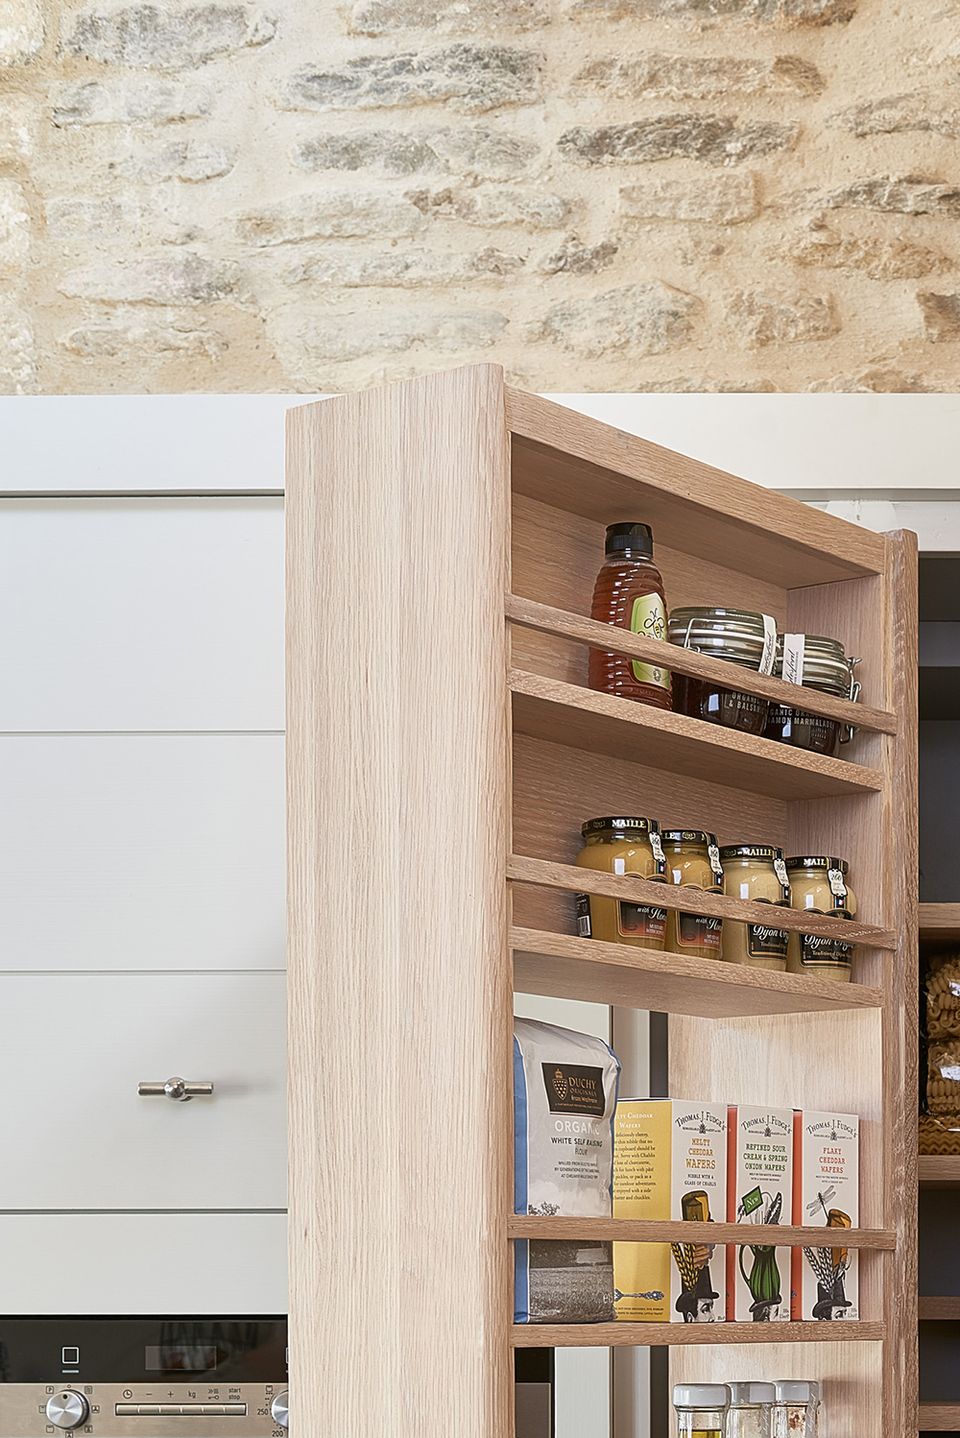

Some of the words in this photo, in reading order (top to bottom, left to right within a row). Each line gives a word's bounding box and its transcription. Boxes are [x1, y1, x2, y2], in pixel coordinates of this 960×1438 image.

[611, 818, 647, 829] MAILLE
[568, 1077, 597, 1090] DUCHY
[550, 1137, 572, 1145] WHITE
[771, 1144, 786, 1153] SOUR
[742, 1152, 763, 1162] CREAM
[685, 1158, 716, 1170] WAFERS
[188, 1390, 197, 1399] kg
[256, 1408, 269, 1416] 250
[271, 1430, 284, 1438] 200
